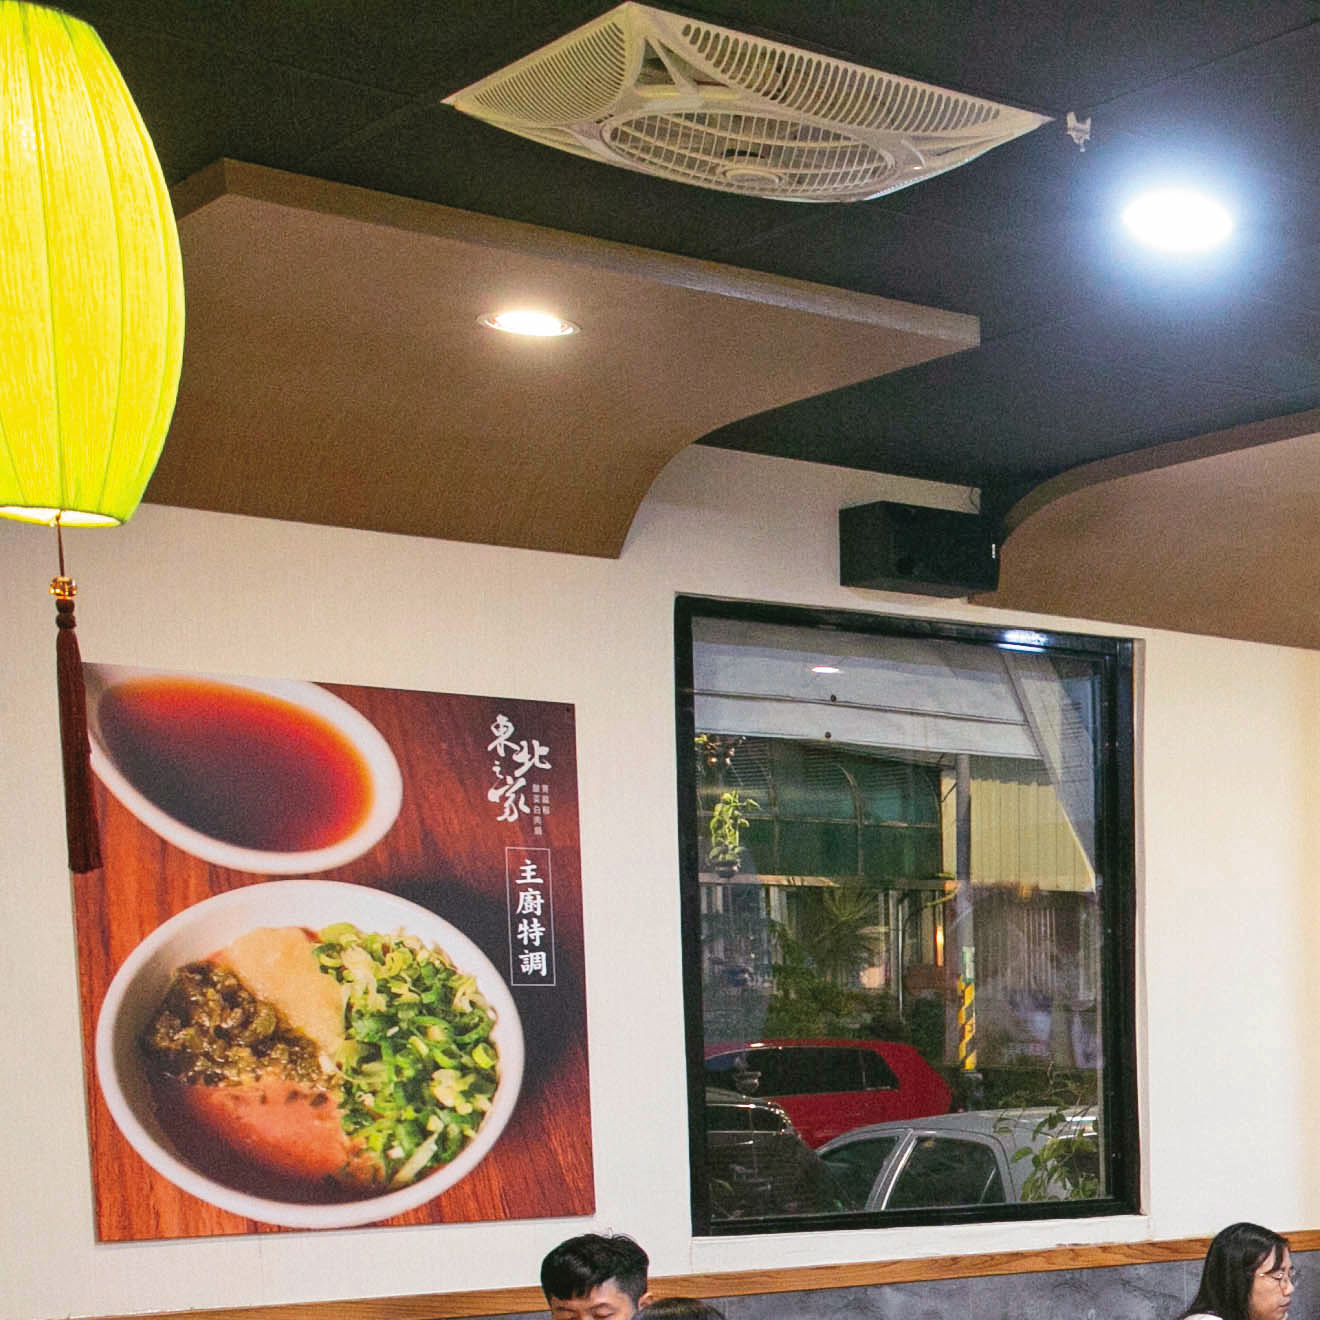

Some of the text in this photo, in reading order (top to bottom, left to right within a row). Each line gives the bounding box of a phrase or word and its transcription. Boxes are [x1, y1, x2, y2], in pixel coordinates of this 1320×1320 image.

[488, 714, 552, 823] 東北之家
[515, 859, 548, 977] 主廚特調
